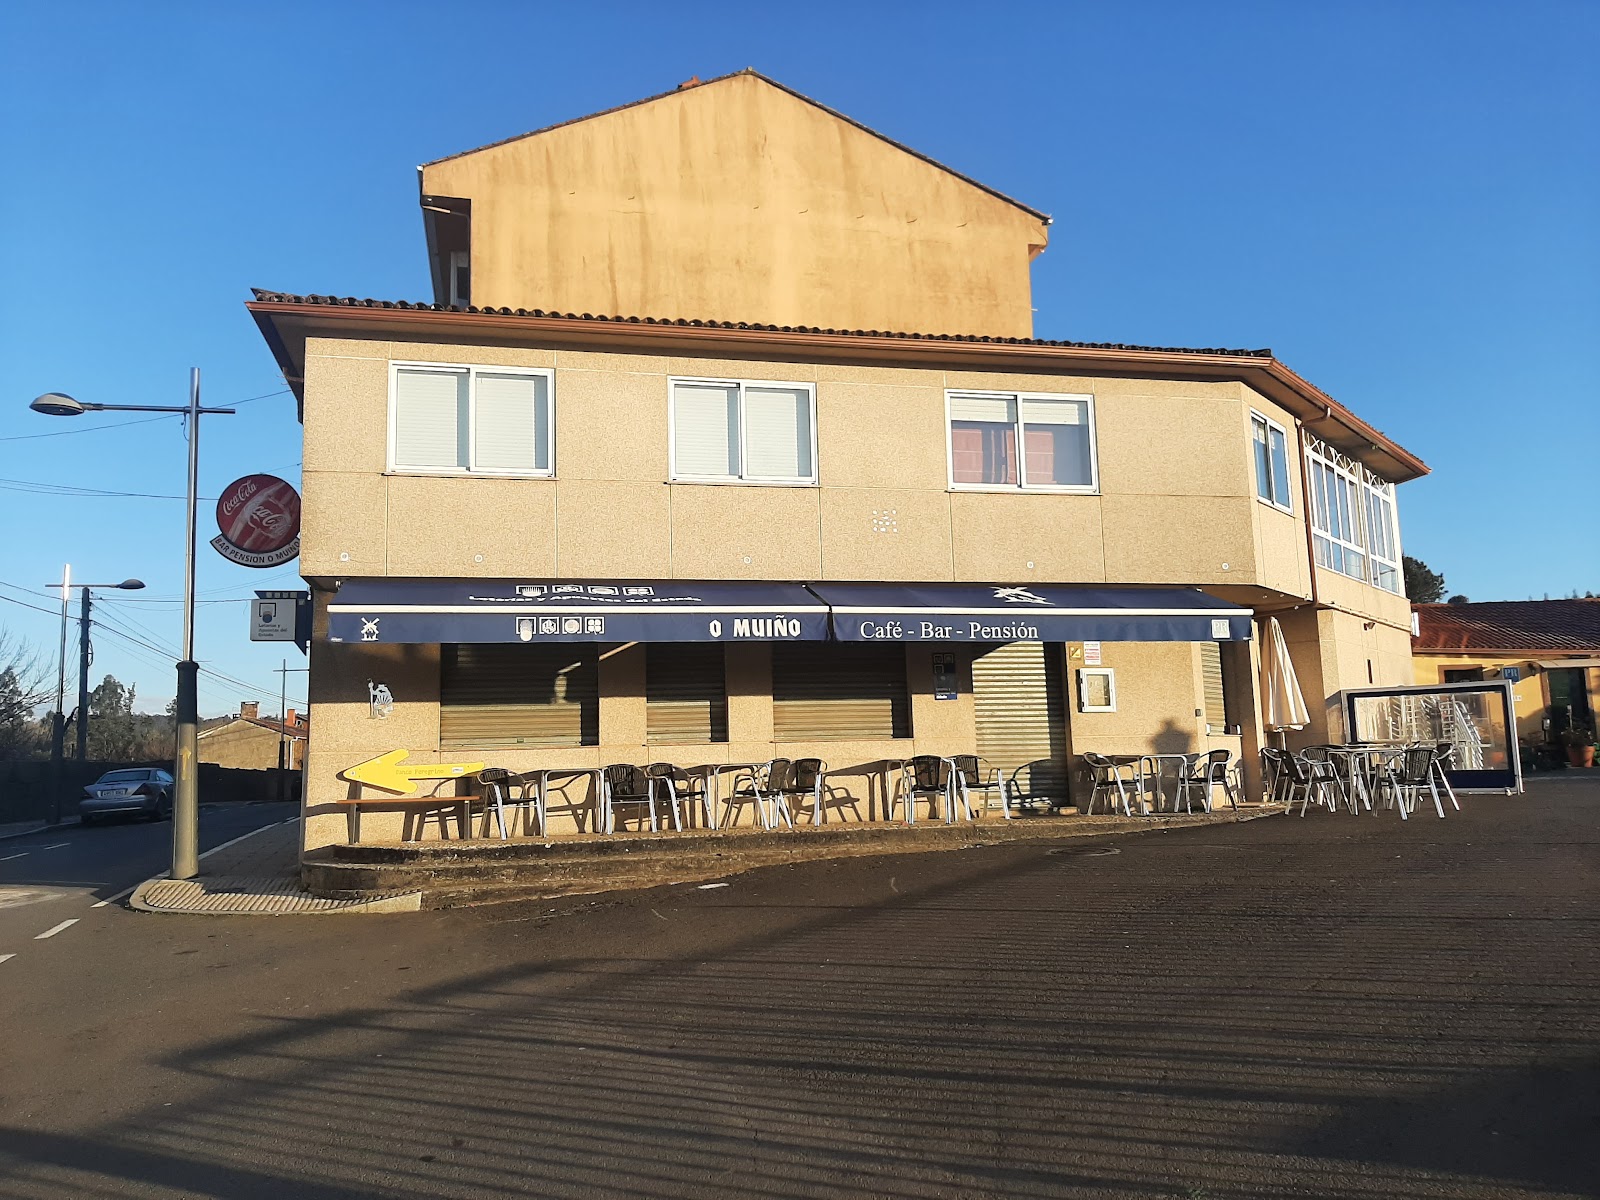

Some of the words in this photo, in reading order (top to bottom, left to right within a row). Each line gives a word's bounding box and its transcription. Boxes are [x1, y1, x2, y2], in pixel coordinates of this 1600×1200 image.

[215, 538, 230, 552] BAR
[230, 549, 265, 563] PENSION
[709, 619, 722, 638] O
[733, 614, 801, 638] MUIÑO
[860, 621, 903, 639] Café
[919, 621, 952, 639] Bar
[969, 621, 1039, 639] Pensión
[1504, 668, 1518, 677] PR
